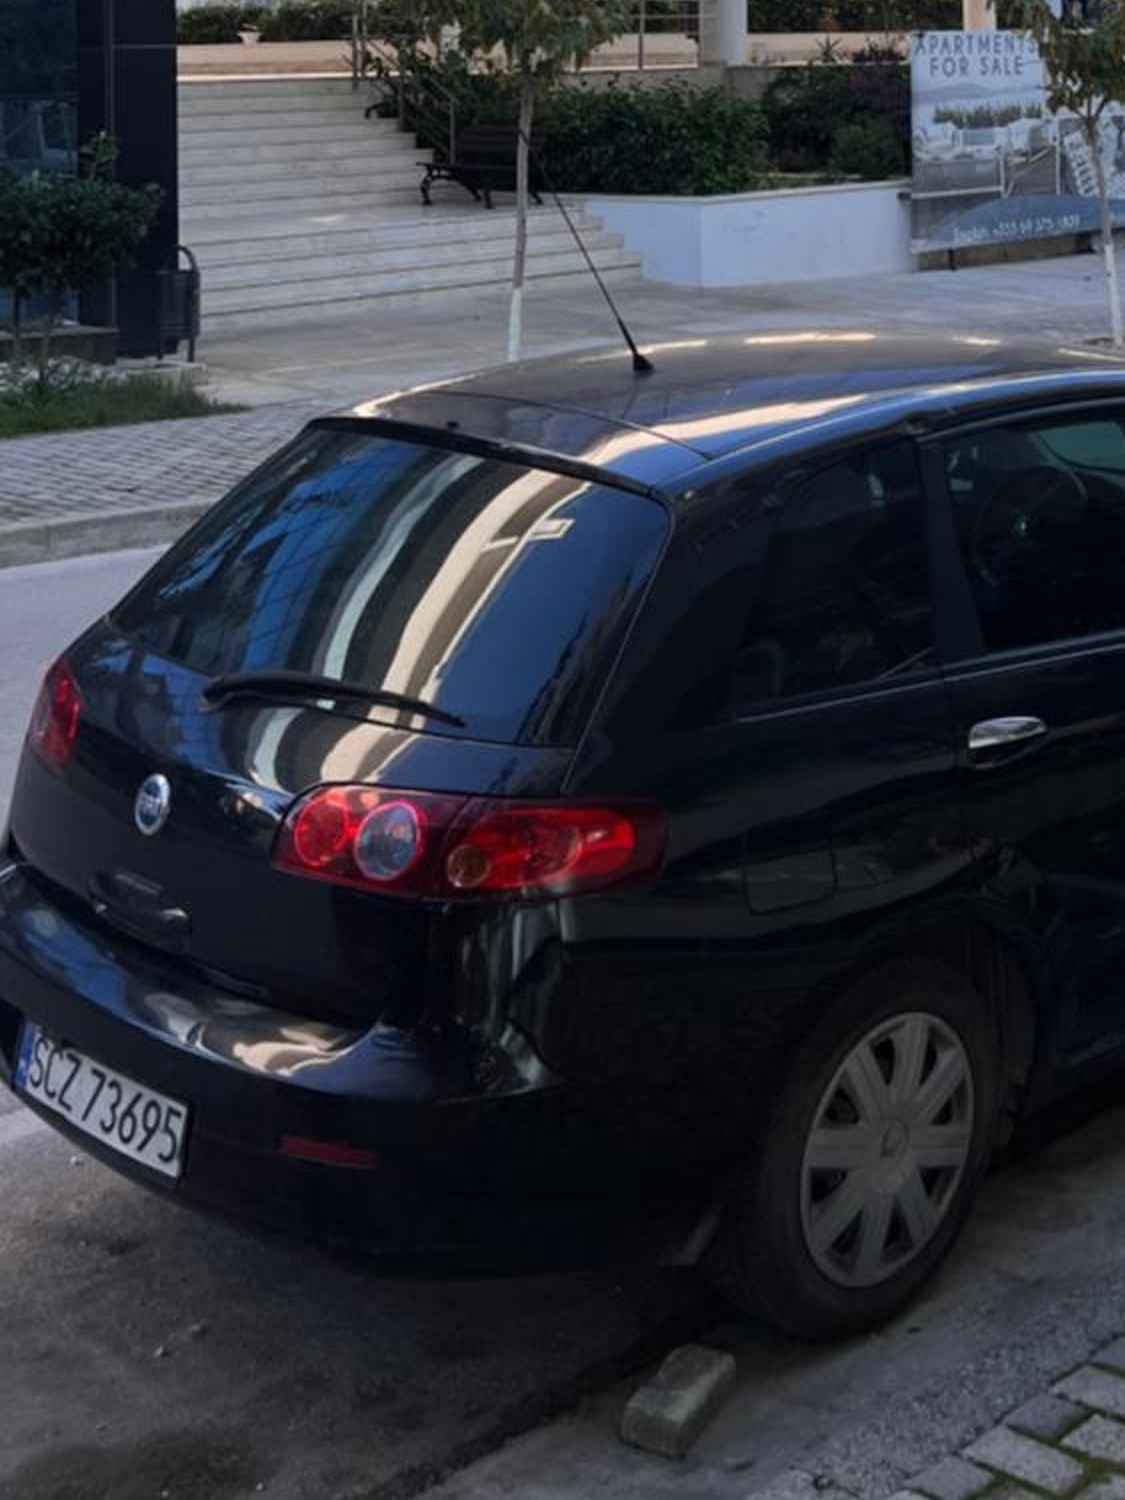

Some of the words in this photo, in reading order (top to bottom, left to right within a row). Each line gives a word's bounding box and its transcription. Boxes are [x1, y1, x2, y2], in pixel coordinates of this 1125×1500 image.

[914, 34, 1035, 56] APARTMENTS
[929, 56, 970, 77] FOR
[980, 56, 1024, 76] SALE
[29, 1036, 81, 1112] SCZ
[82, 1067, 182, 1163] 73695
